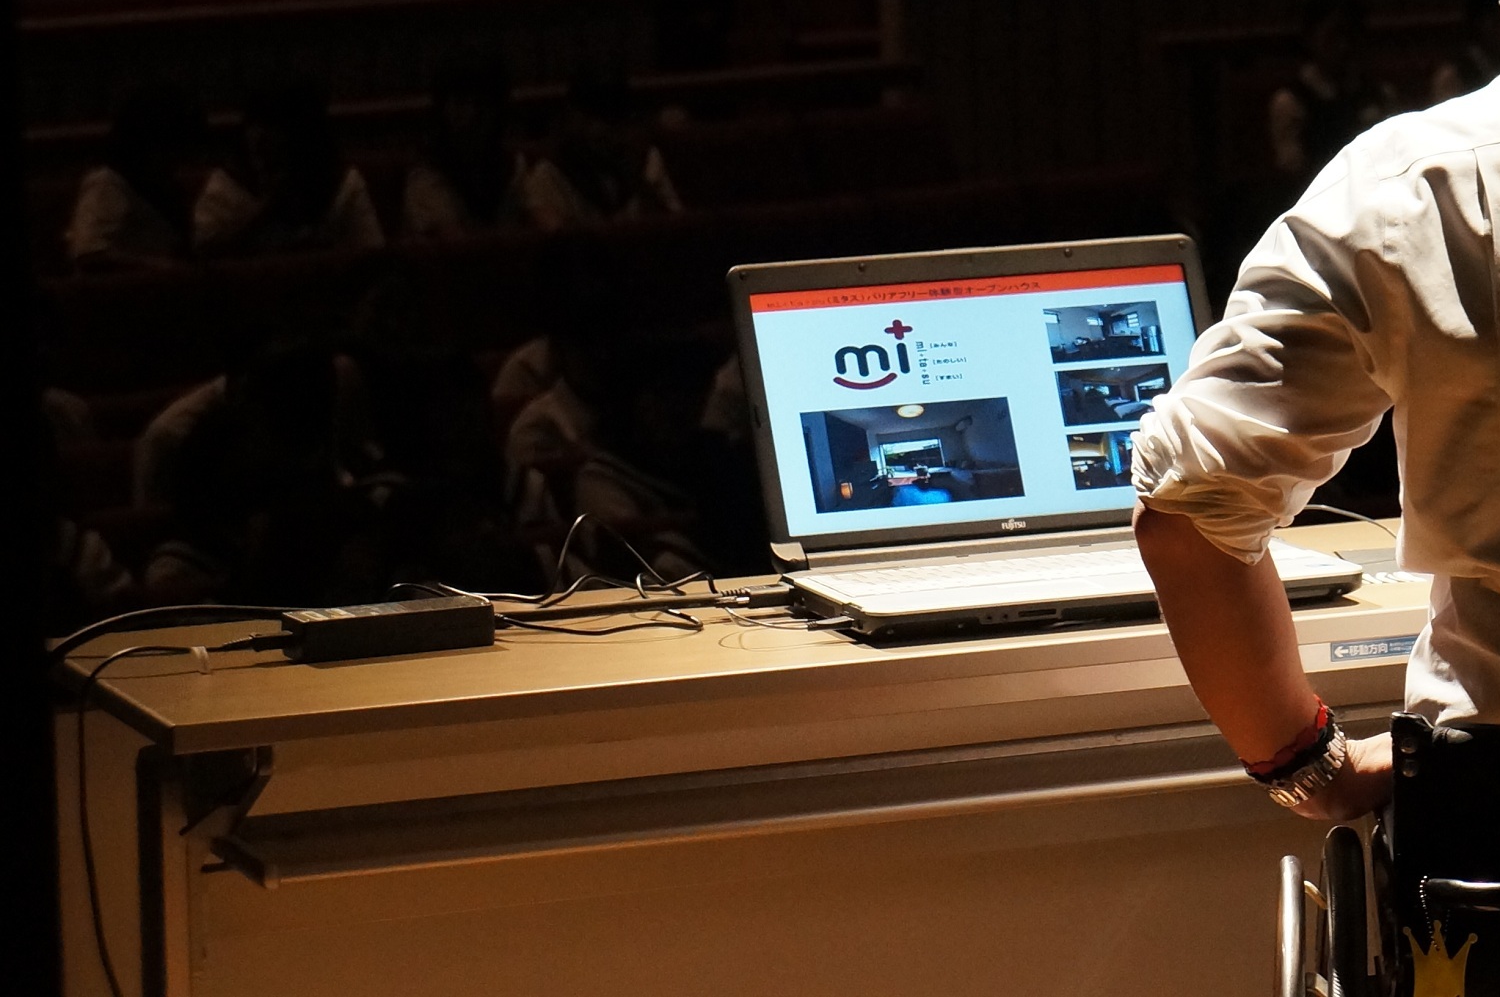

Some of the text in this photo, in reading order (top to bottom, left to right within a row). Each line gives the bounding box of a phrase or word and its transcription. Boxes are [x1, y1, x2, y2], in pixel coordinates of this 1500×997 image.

[1001, 518, 1027, 531] FUJITSU
[1349, 642, 1388, 657] 移動方向
